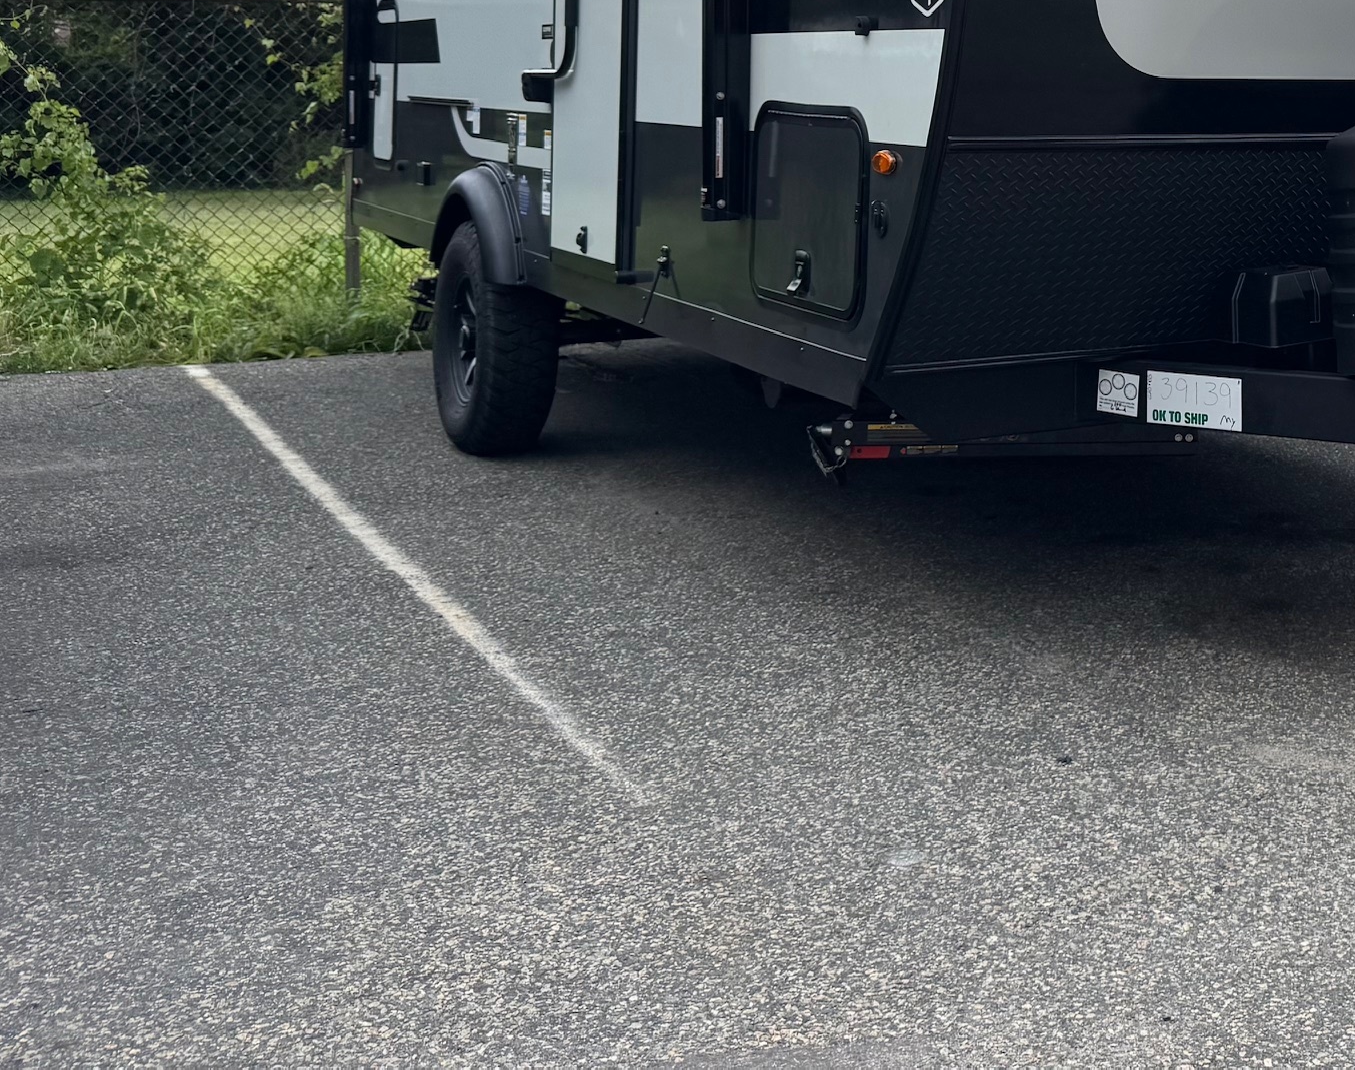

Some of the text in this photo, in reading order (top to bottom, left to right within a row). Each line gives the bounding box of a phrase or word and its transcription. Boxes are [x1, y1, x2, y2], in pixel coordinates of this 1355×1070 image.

[1160, 377, 1232, 409] 39139
[1152, 409, 1209, 426] OK TO SHIP
